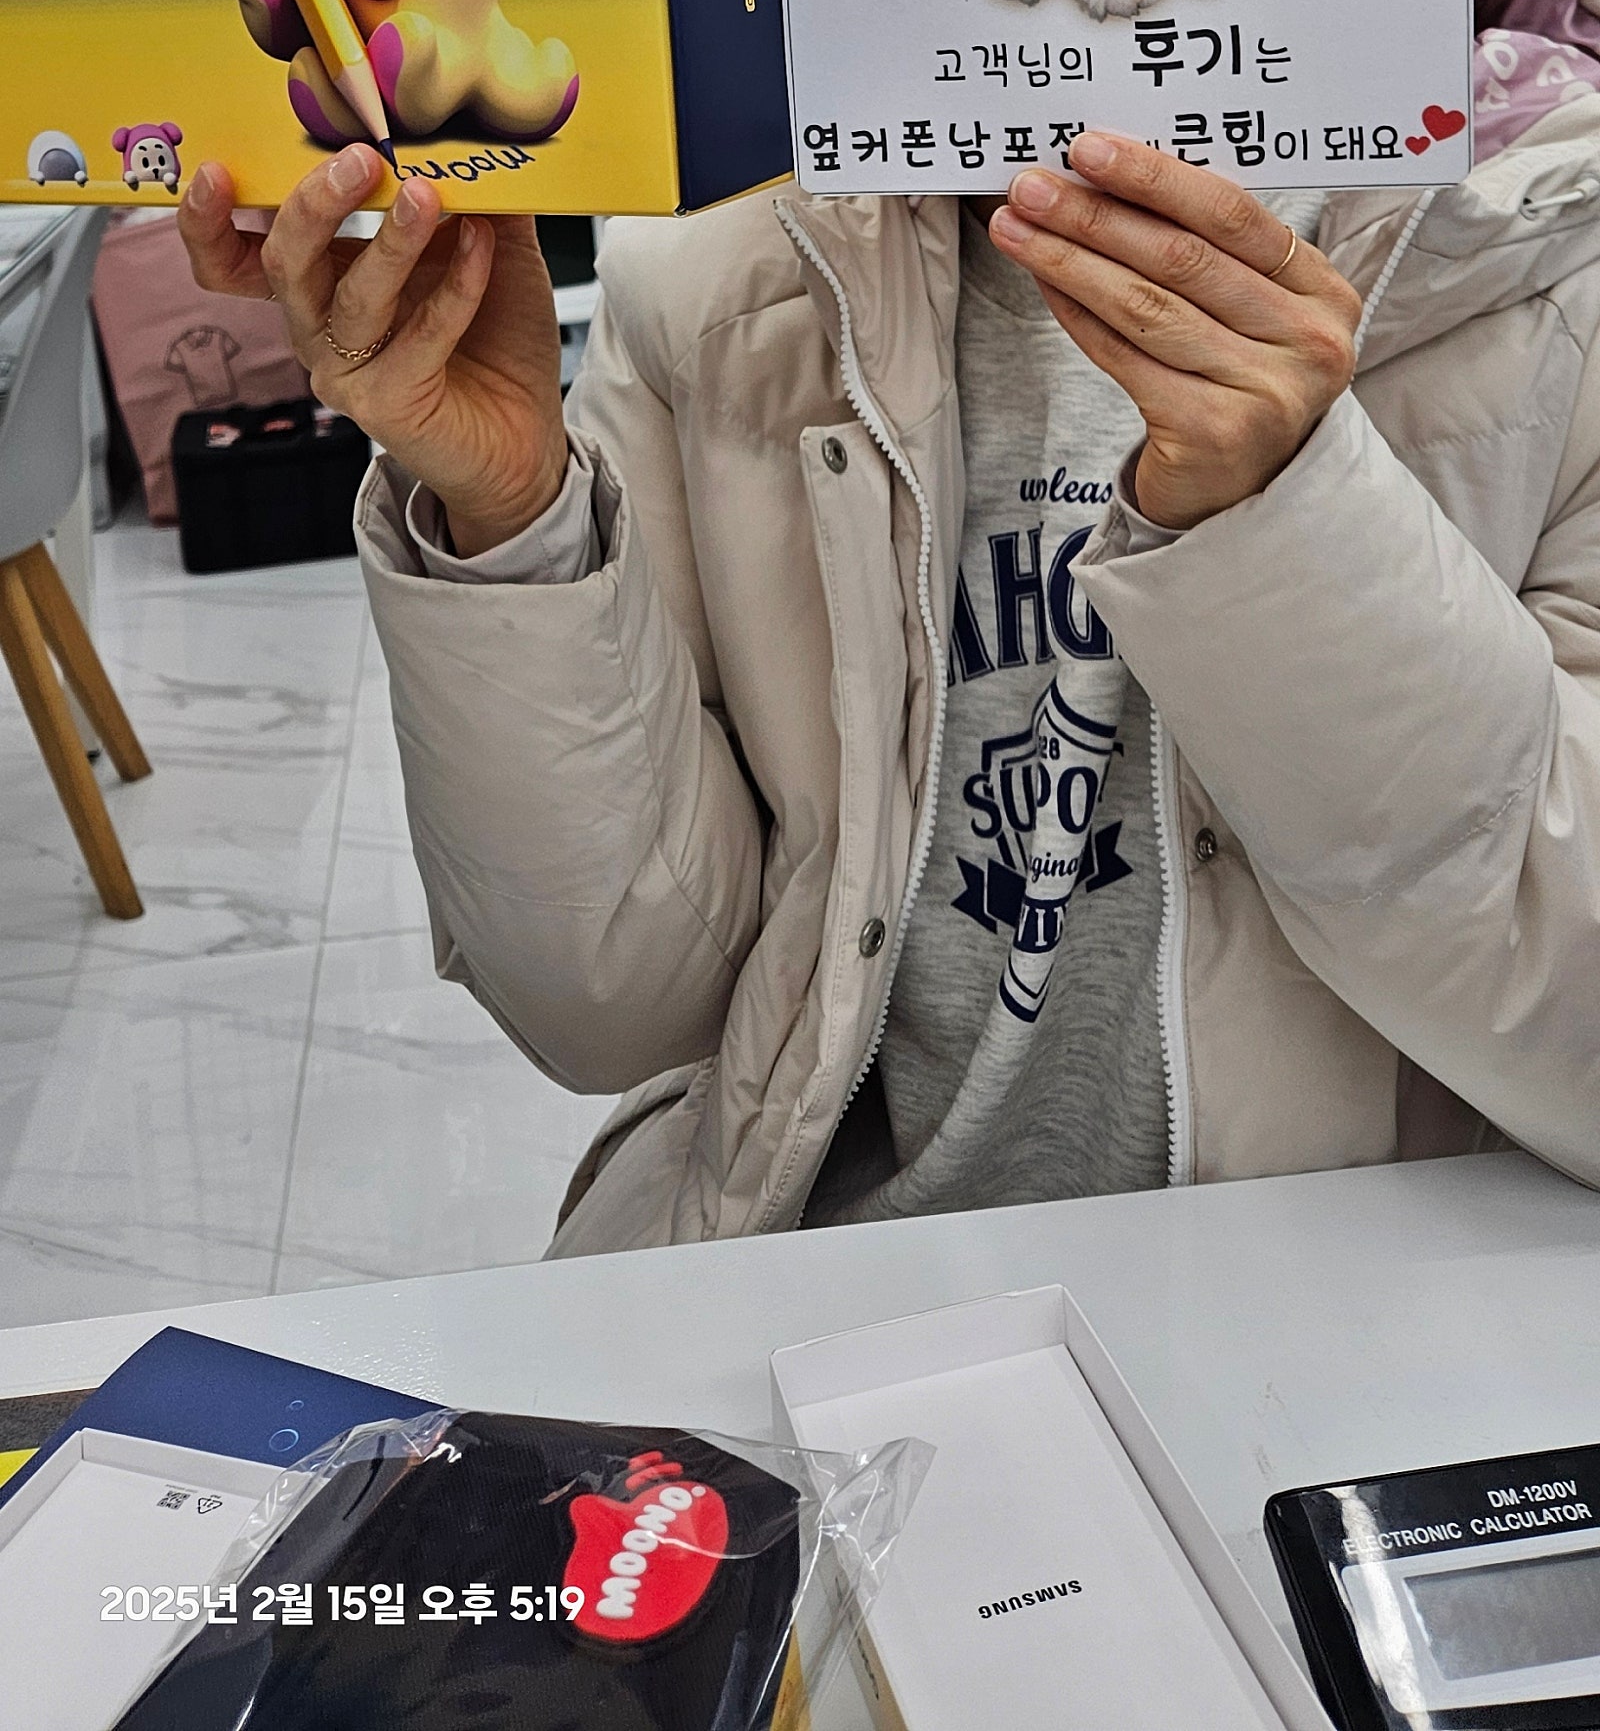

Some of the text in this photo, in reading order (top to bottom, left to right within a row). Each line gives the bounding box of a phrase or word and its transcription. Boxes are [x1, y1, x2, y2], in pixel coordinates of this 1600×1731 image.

[933, 42, 1094, 88] 고객님의
[1487, 1479, 1578, 1509] DM-1200V
[1342, 1503, 1593, 1555] ELECTRONIC CALCULATOR
[977, 1579, 1083, 1619] SAMSUNG
